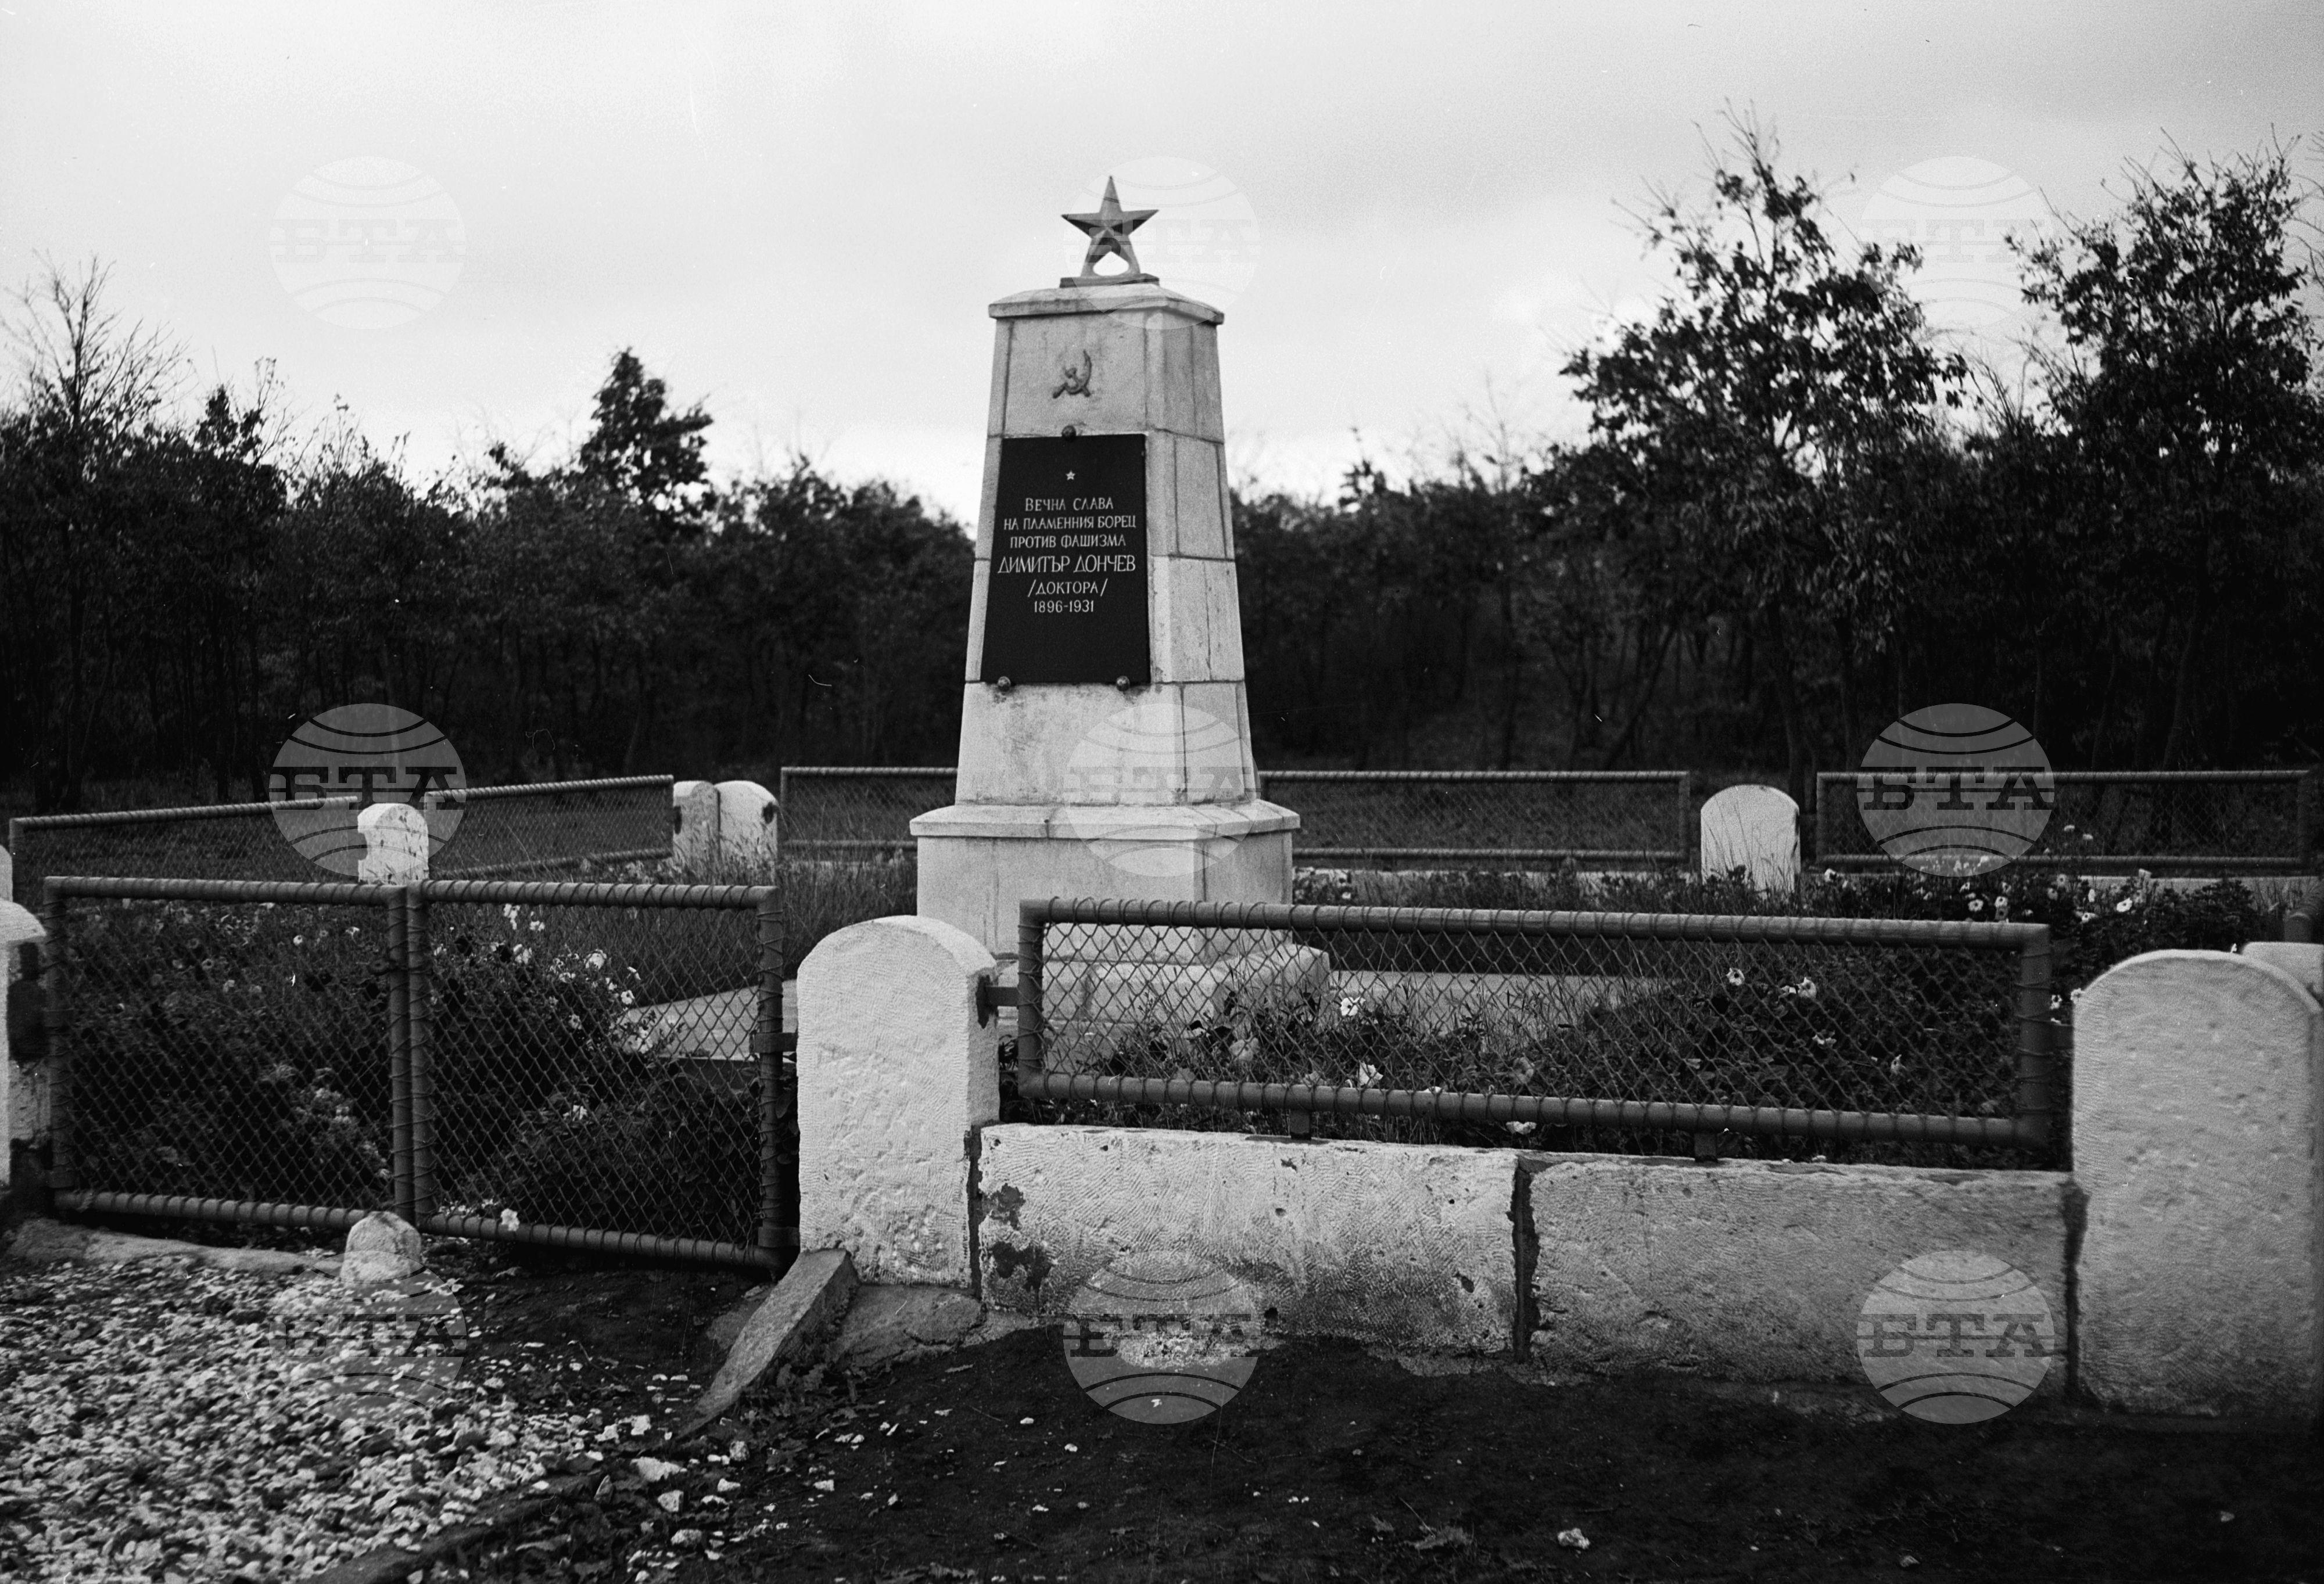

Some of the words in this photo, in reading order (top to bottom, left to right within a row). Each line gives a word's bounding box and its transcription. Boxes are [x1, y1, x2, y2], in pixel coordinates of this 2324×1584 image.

[1025, 497, 1066, 512] ВЕЧНА
[1073, 497, 1114, 511] СЛАВА
[1003, 518, 1019, 530] НА
[1023, 516, 1095, 530] ПЛАМЕННИЯ
[1097, 515, 1136, 529] БОРЕЦ
[1010, 535, 1057, 548] ПРОТИВ
[1060, 534, 1127, 548] ФАШИЗМА
[997, 555, 1071, 574] ДИМИТЪР
[1073, 554, 1136, 573] ДОНЧЕВ
[1027, 578, 1109, 598] /ДОКТОРА/
[1034, 599, 1095, 613] 1896-1931
